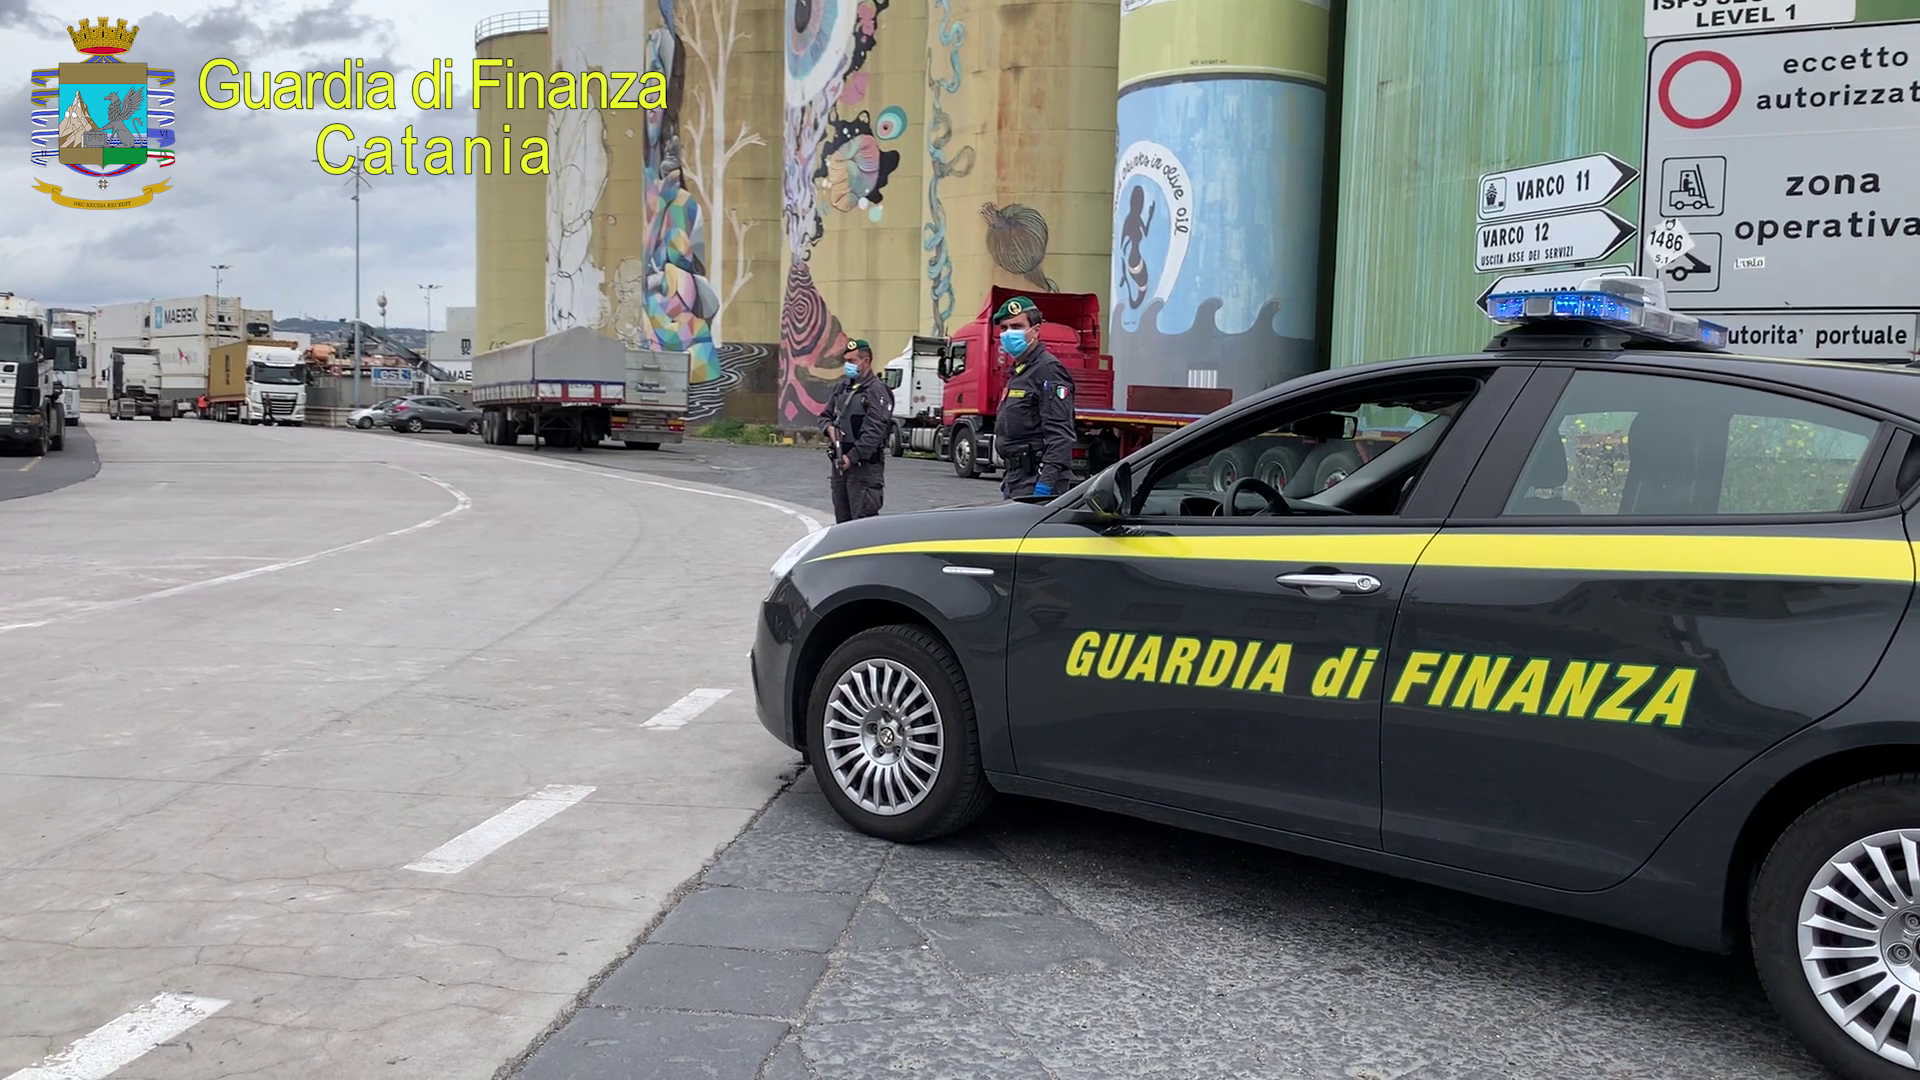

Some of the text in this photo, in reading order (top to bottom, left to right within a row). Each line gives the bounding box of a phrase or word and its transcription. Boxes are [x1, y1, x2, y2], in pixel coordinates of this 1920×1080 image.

[1696, 5, 1797, 28] LEVEL 1
[1783, 46, 1909, 74] eccetto
[1756, 80, 1920, 110] autorizzat
[1516, 169, 1590, 202] VARCO 11
[1785, 173, 1881, 197] zona
[1162, 164, 1184, 201] olive
[1174, 207, 1189, 237] oil
[1482, 222, 1550, 249] VARCO 12
[1650, 230, 1684, 251] 1486
[1734, 210, 1920, 246] operativa
[1481, 246, 1574, 267] USCITA ASSE DEI SERVIZI
[164, 307, 198, 323] MAERSK
[1727, 324, 1908, 349] utorita' portuale
[1065, 631, 1698, 727] GUARDIA di FINANZA
